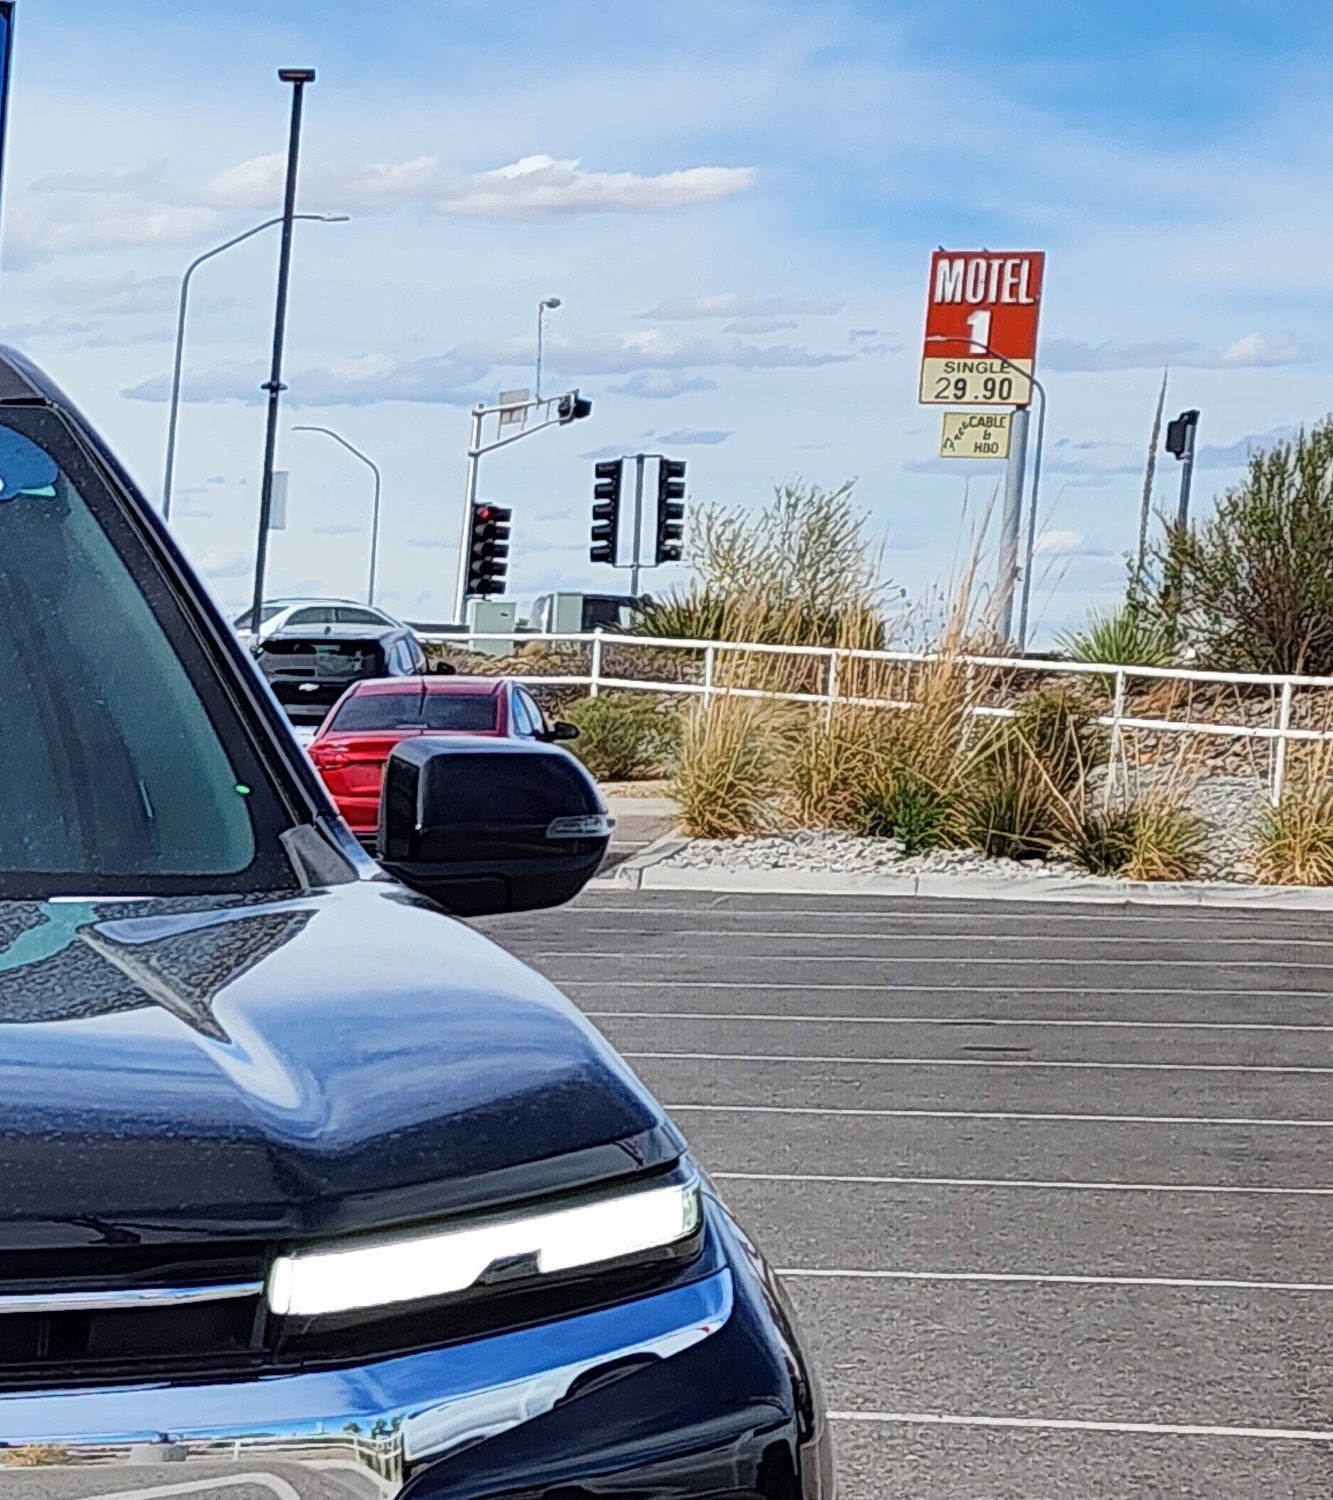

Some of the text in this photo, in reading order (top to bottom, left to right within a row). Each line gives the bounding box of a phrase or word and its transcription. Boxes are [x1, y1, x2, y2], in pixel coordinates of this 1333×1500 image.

[934, 257, 1035, 304] MOTEL
[967, 309, 991, 354] 1
[943, 361, 1012, 374] SINGLE
[934, 376, 1013, 401] 29.90
